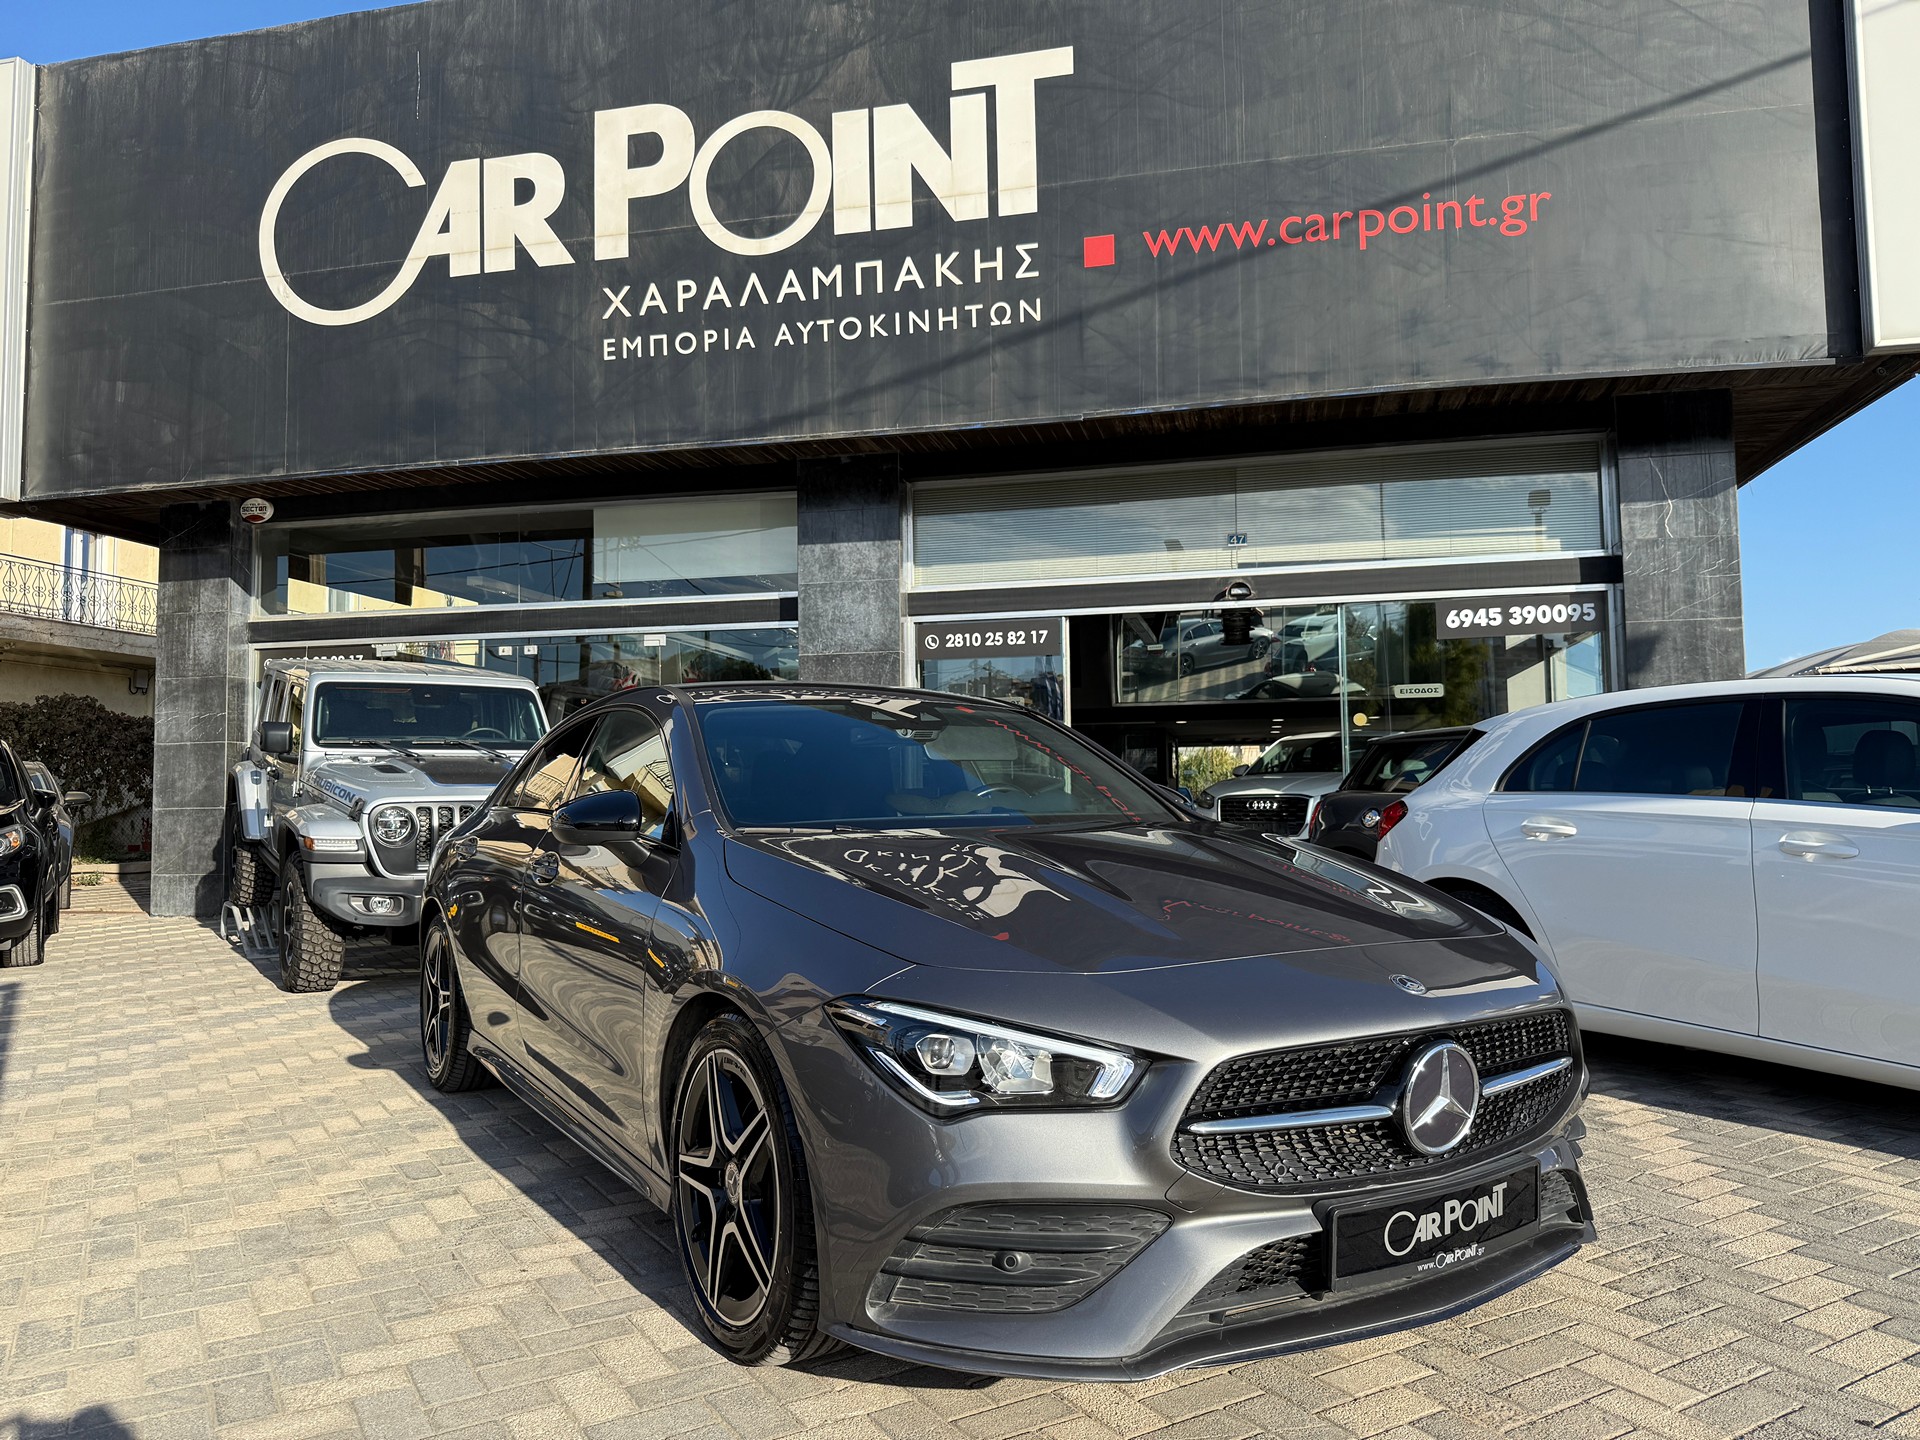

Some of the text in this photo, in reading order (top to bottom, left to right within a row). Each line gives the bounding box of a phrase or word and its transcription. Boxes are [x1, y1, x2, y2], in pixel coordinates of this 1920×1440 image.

[259, 45, 1075, 326] CAR POINT
[1143, 192, 1552, 257] www.carpoint.gr
[601, 242, 1040, 320] ΧΑΡΑΛΑΜΠΑΚΗΣ
[603, 298, 1042, 361] ΕΜΠΟΡΙΑ ΑΥΤΟΚΙΝΗΤΩΝ
[1230, 535, 1245, 545] 47
[1445, 602, 1596, 629] 6945 390095
[945, 629, 1049, 648] 2810 25 82 17
[1399, 687, 1440, 695] ΕΙΣΟΔΟΣ
[313, 776, 356, 803] RUBICON
[1384, 1181, 1508, 1257] CAR POINT
